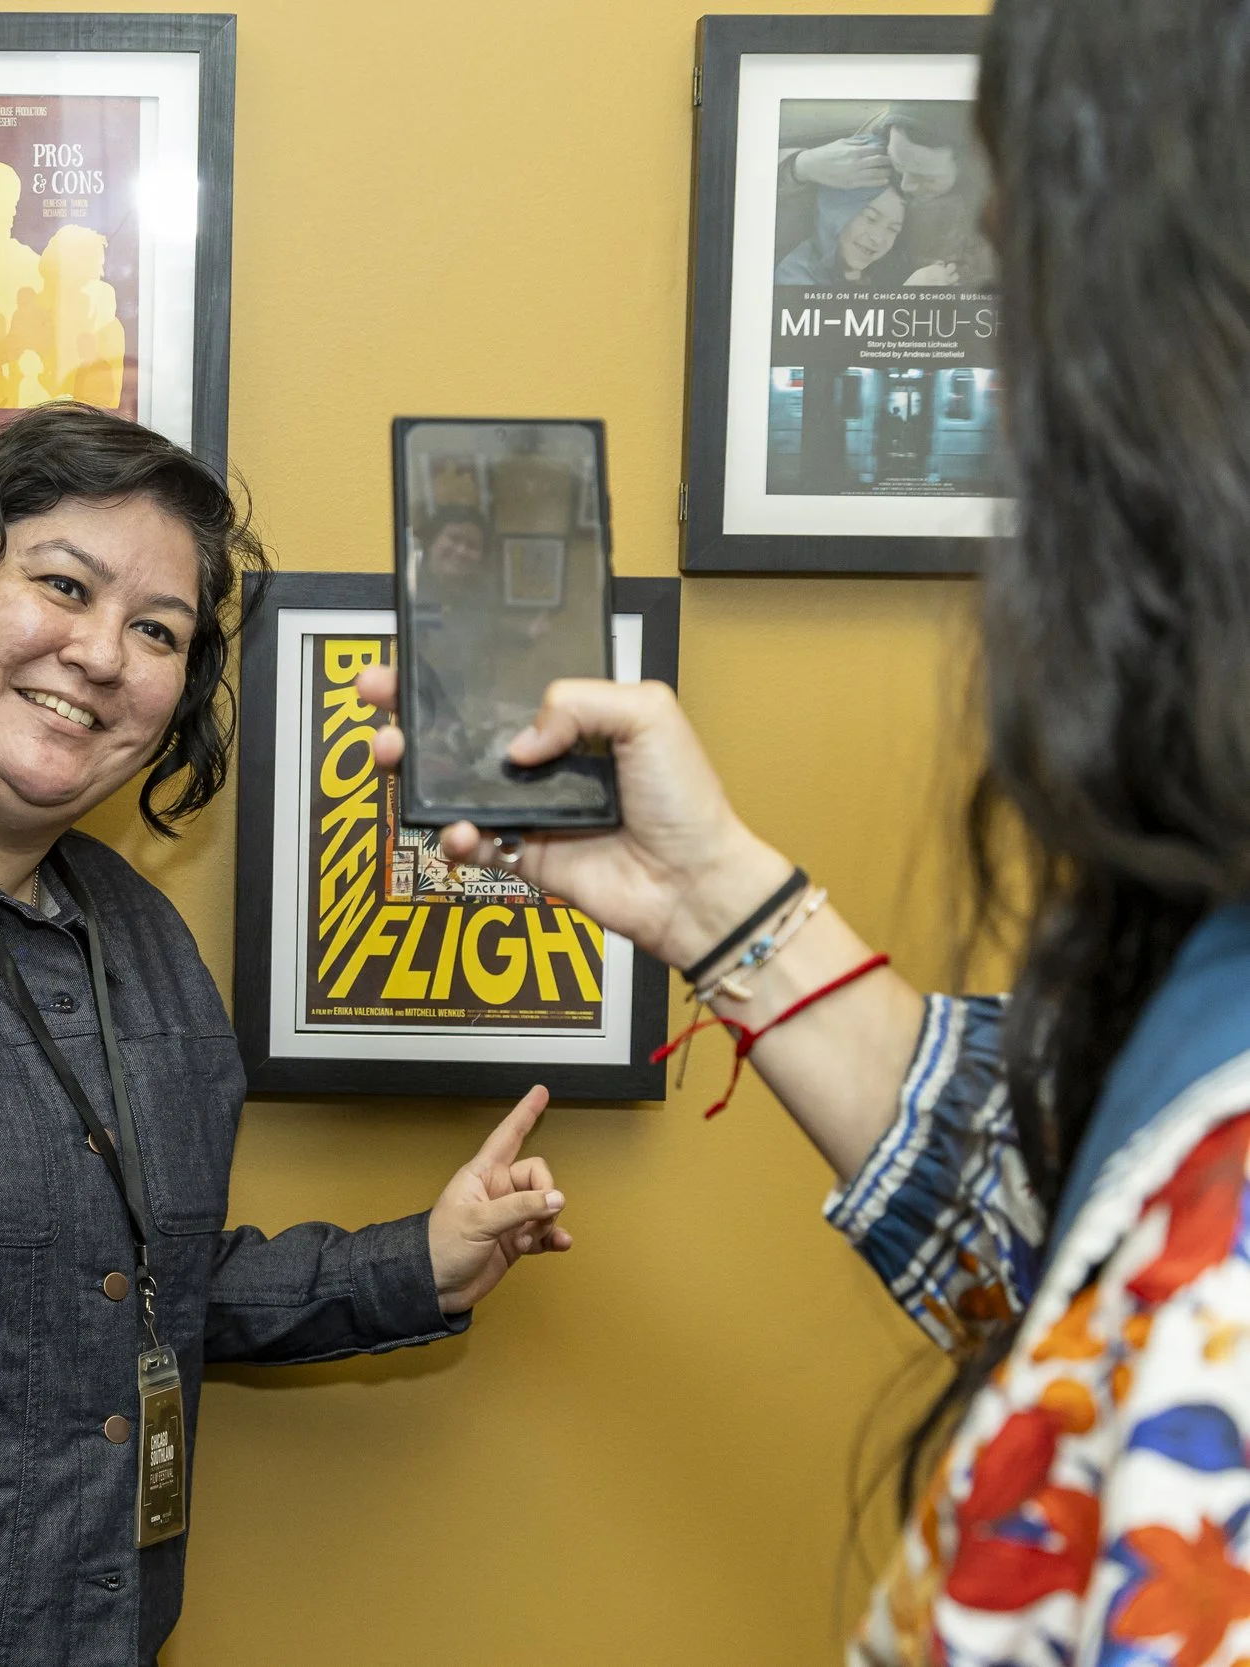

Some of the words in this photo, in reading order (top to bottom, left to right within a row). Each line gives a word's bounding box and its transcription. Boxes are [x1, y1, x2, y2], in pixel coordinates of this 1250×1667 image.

[15, 107, 47, 116] PRODUCTIONS
[33, 144, 83, 167] PROS
[33, 173, 46, 194] &
[52, 171, 104, 194] CONS
[781, 309, 884, 336] MI-MI
[867, 341, 886, 349] Story
[887, 341, 897, 349] by
[860, 350, 890, 358] Directed
[891, 350, 902, 359] by
[318, 640, 381, 984] BROKEN
[467, 885, 496, 894] JACK
[501, 885, 525, 894] PINE
[334, 1007, 353, 1015] ERIKA
[354, 1007, 394, 1016] VALENCIANA
[405, 1008, 437, 1017] MITCHELL
[438, 1009, 465, 1018] WENKUS
